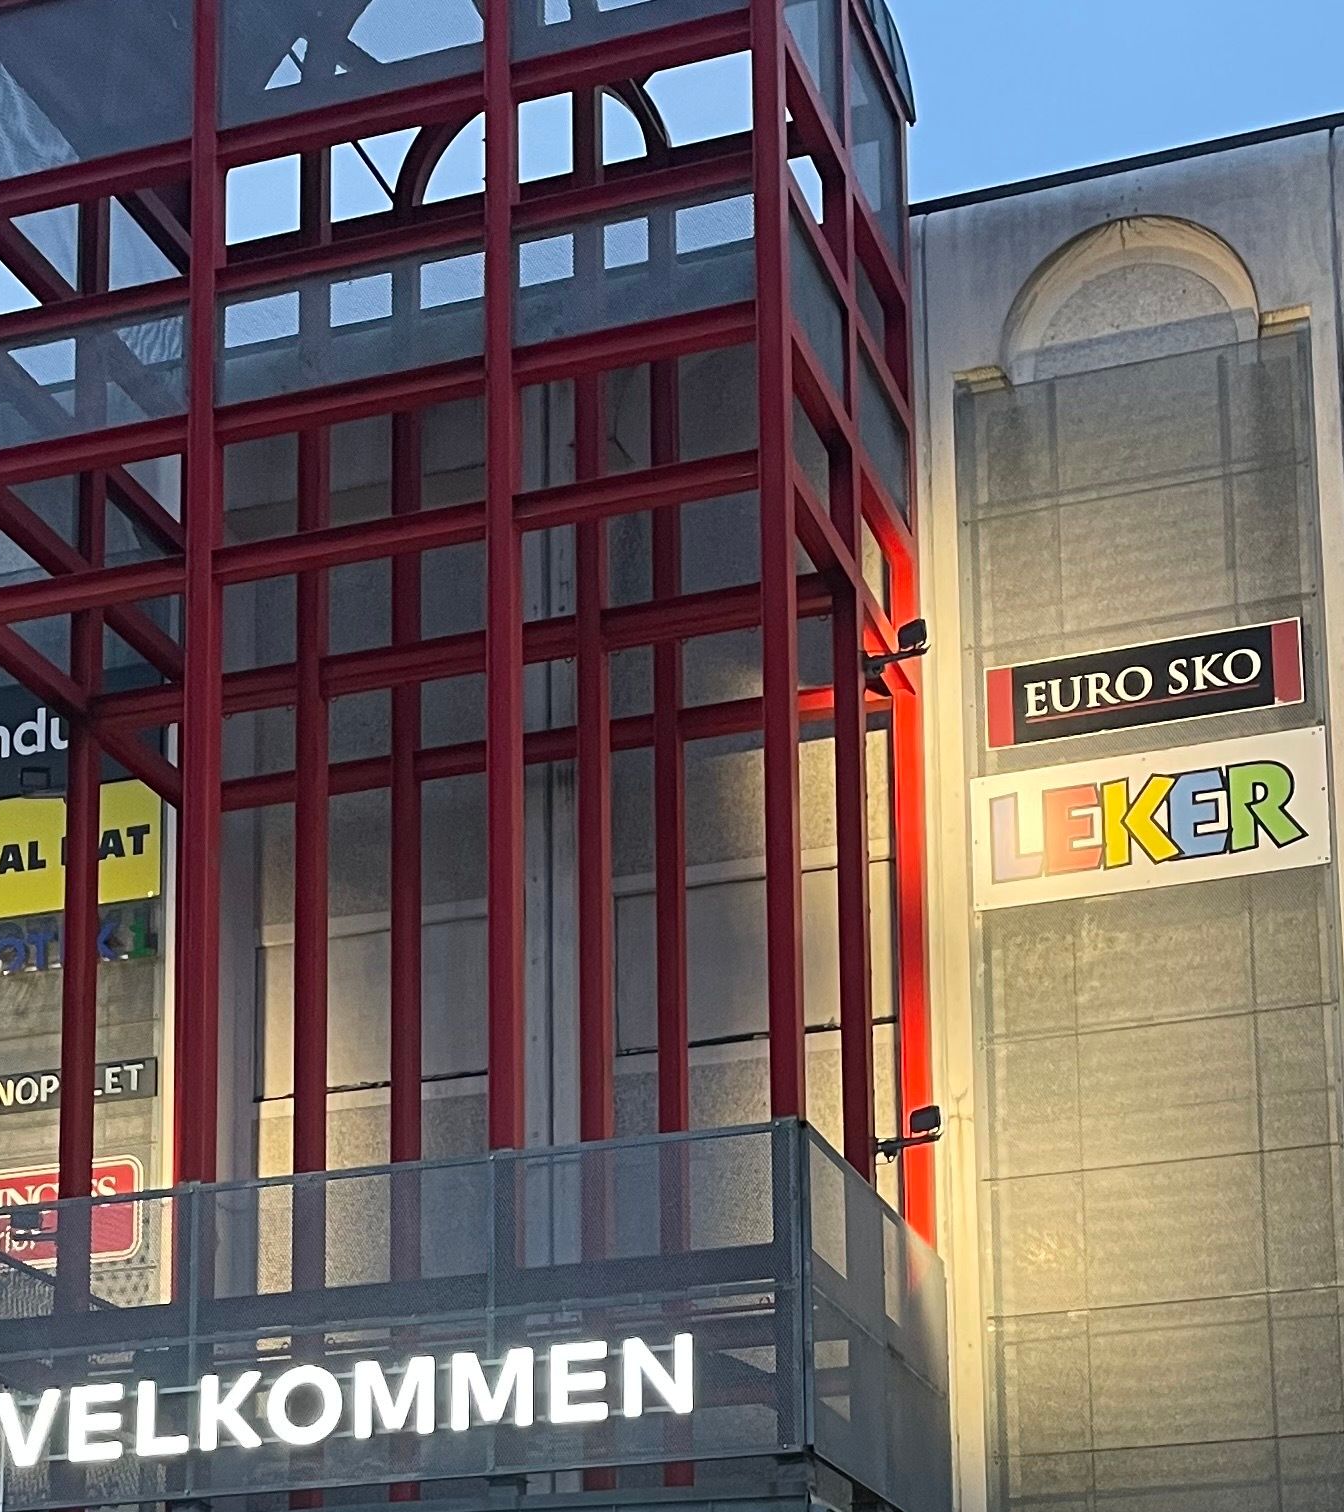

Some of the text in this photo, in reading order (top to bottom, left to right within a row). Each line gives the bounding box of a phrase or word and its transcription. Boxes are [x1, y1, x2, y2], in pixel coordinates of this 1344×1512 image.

[1023, 647, 1262, 718] EURO SKO
[989, 759, 1309, 885] LEKER
